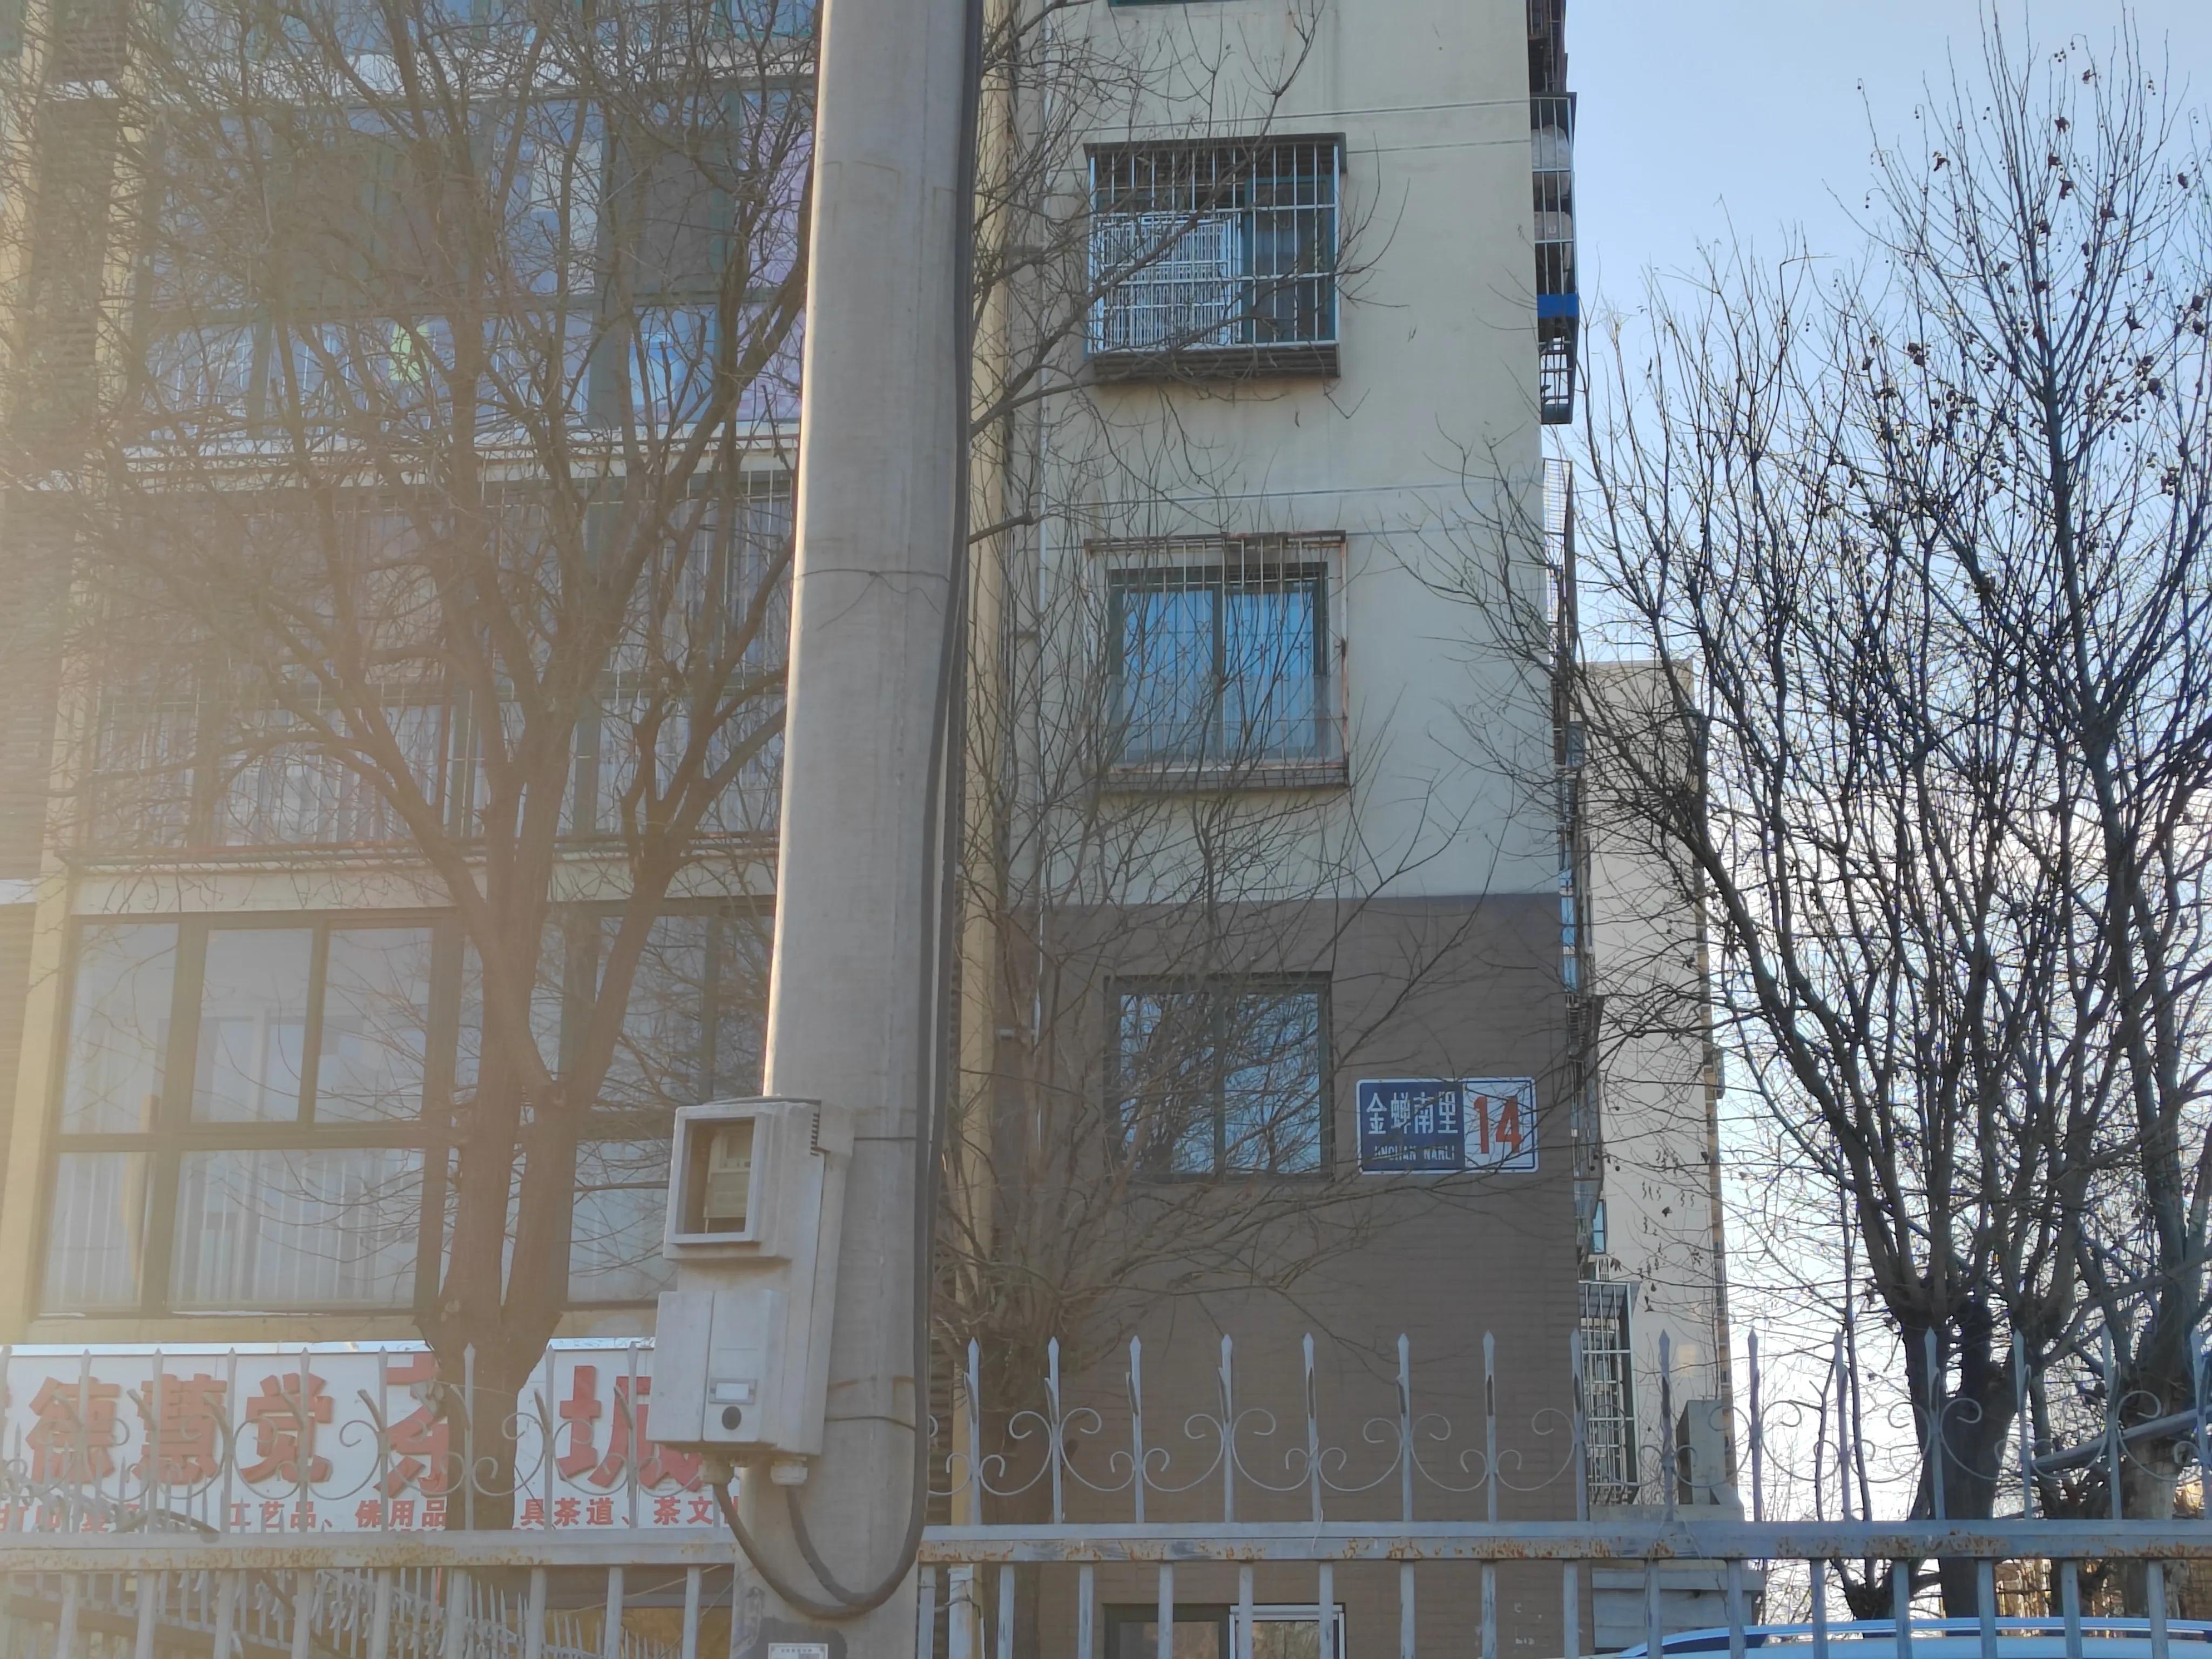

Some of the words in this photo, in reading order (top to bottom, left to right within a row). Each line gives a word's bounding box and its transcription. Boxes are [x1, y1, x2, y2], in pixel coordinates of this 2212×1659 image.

[1366, 1091, 1458, 1134] 金蝉南里
[1474, 1095, 1523, 1154] 14
